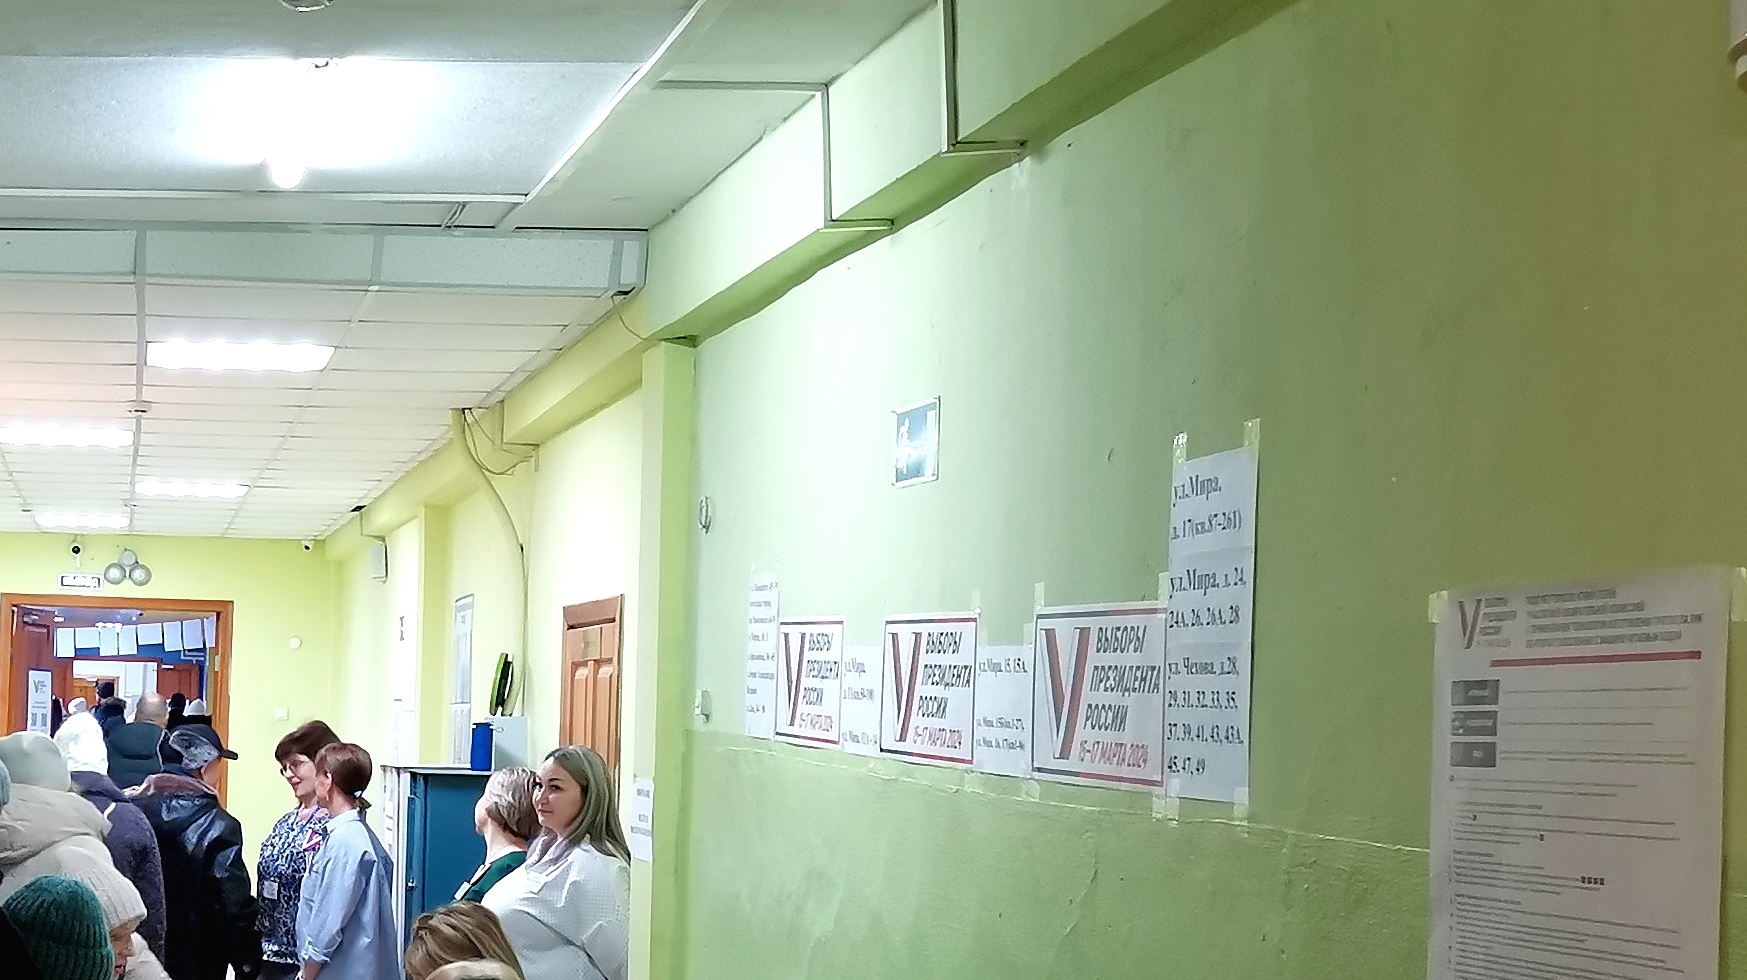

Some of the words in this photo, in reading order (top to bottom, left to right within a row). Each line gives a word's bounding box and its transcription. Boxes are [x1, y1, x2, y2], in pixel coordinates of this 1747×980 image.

[1229, 605, 1241, 625] 28
[925, 631, 963, 655] ВЫБОРЫ
[1095, 624, 1148, 654] ВЫБОРЫ
[921, 663, 973, 691] ПРЕЗИДЕНТА
[1089, 664, 1161, 698] ПРЕЗИДЕНТА
[916, 695, 949, 720] РОССИИ
[1083, 702, 1129, 733] РОССИИ
[1097, 741, 1127, 767] МАРТА
[1126, 743, 1149, 770] 2024
